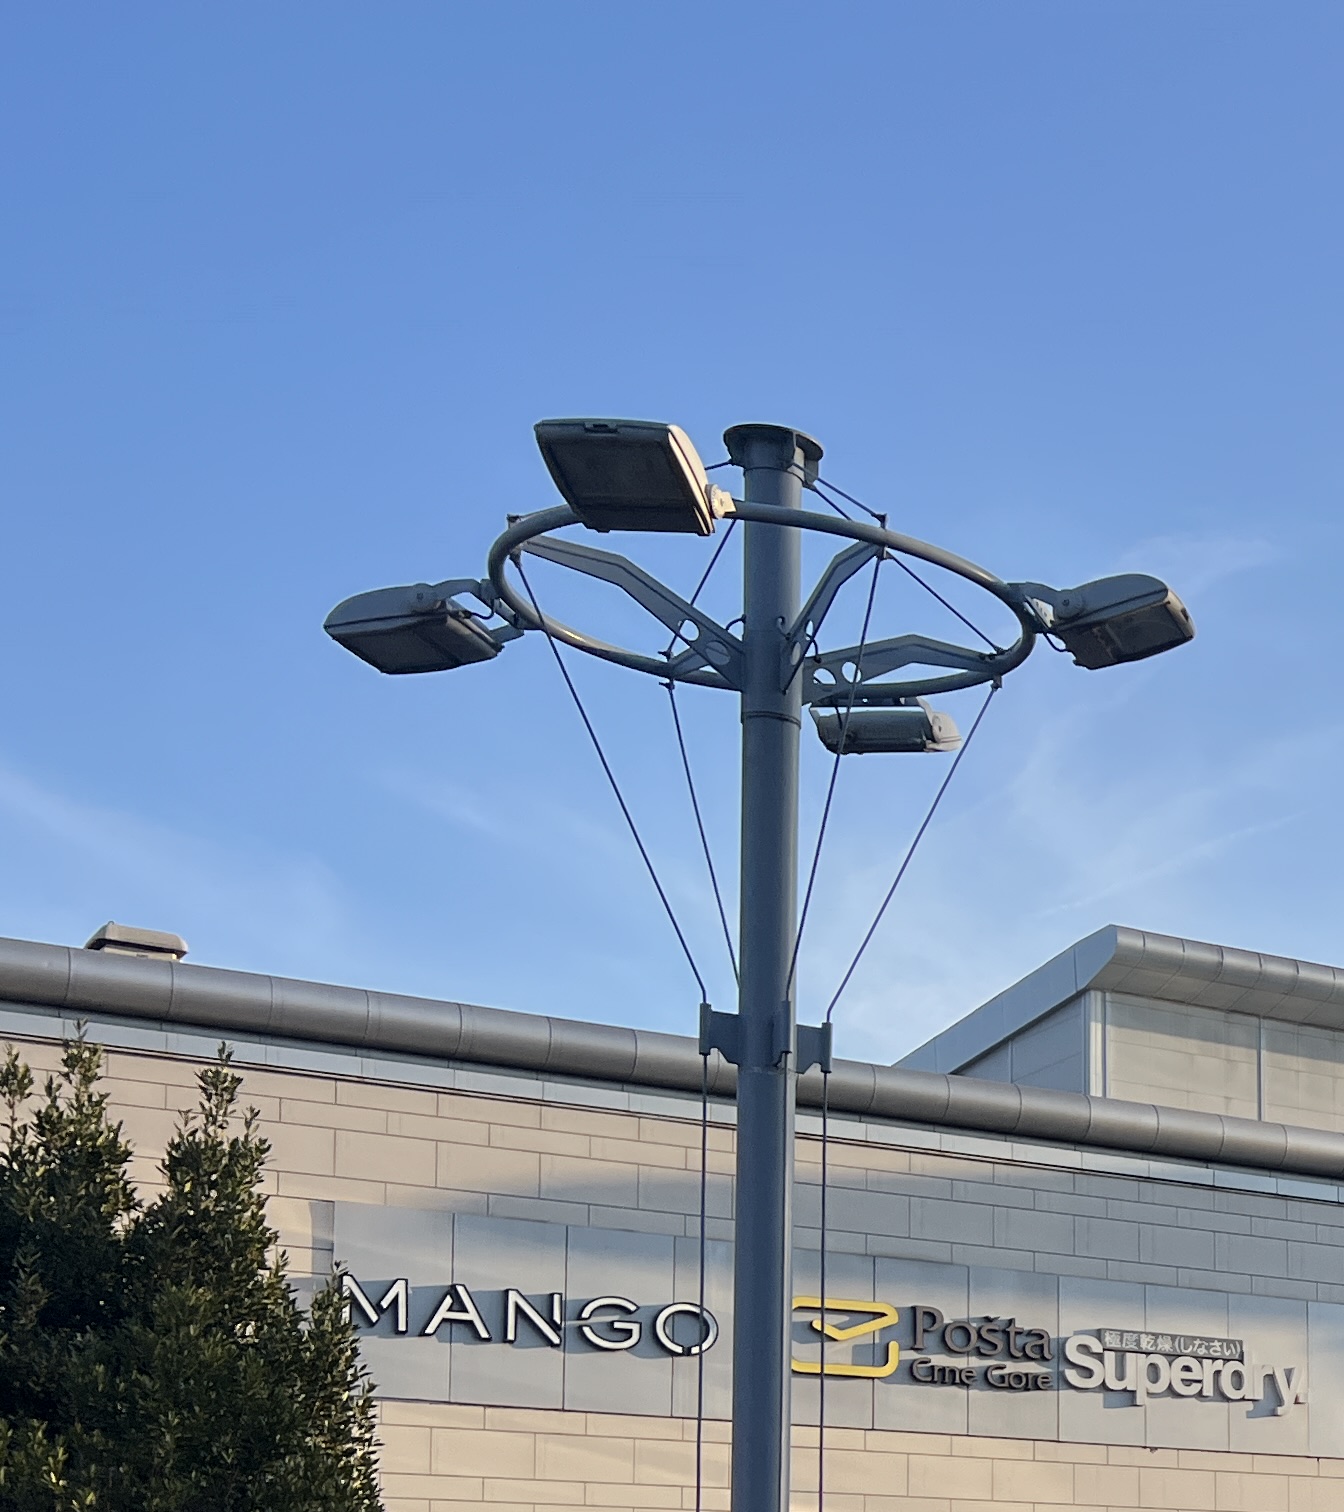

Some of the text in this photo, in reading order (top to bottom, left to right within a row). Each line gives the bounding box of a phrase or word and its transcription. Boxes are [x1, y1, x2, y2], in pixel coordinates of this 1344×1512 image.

[341, 1274, 719, 1356] MANGO
[911, 1305, 1053, 1361] Pošta
[911, 1357, 1053, 1391] Crne Gore
